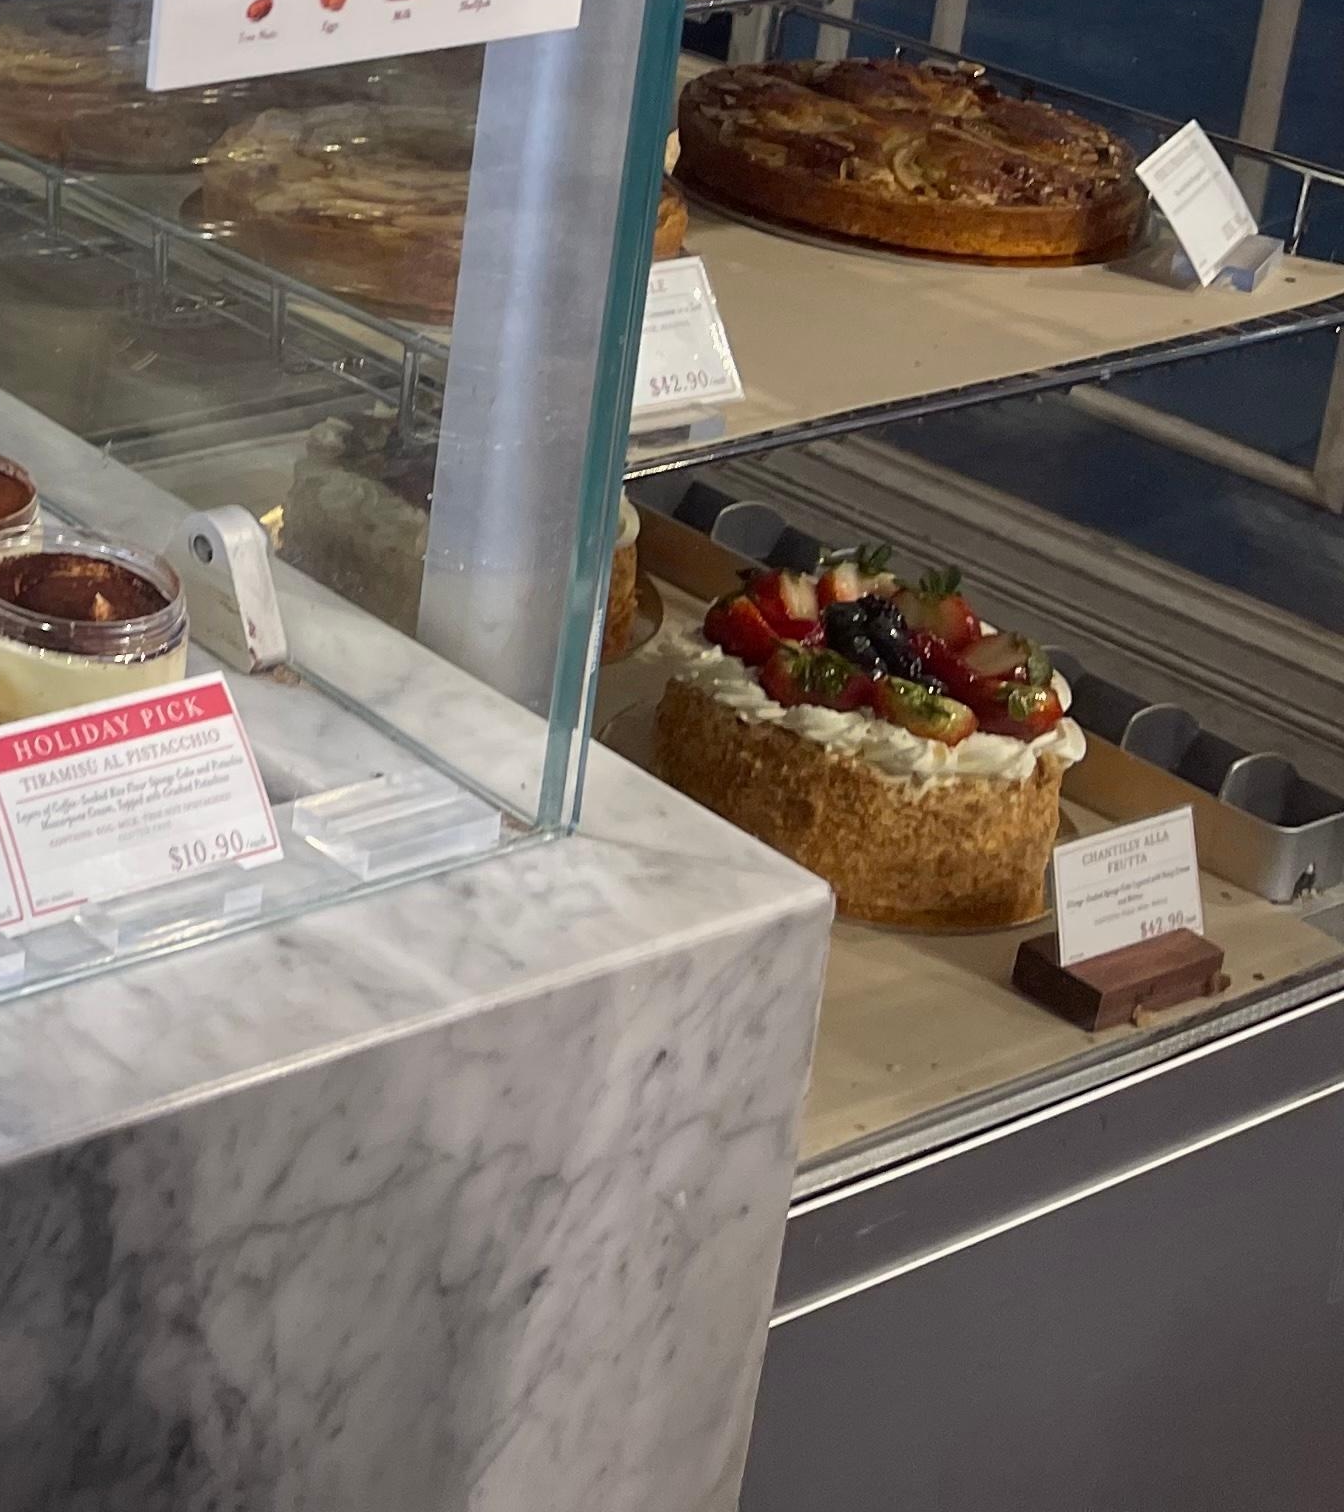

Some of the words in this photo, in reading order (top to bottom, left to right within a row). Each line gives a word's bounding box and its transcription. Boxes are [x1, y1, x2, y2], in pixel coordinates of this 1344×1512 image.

[11, 709, 133, 765] HOLIDAY
[138, 692, 205, 731] PICK
[100, 751, 125, 772] AL
[123, 723, 221, 767] PISTACCHIO
[166, 826, 246, 873] $10.90
[1081, 837, 1140, 866] CHANTILLY
[1143, 828, 1169, 847] ALLA
